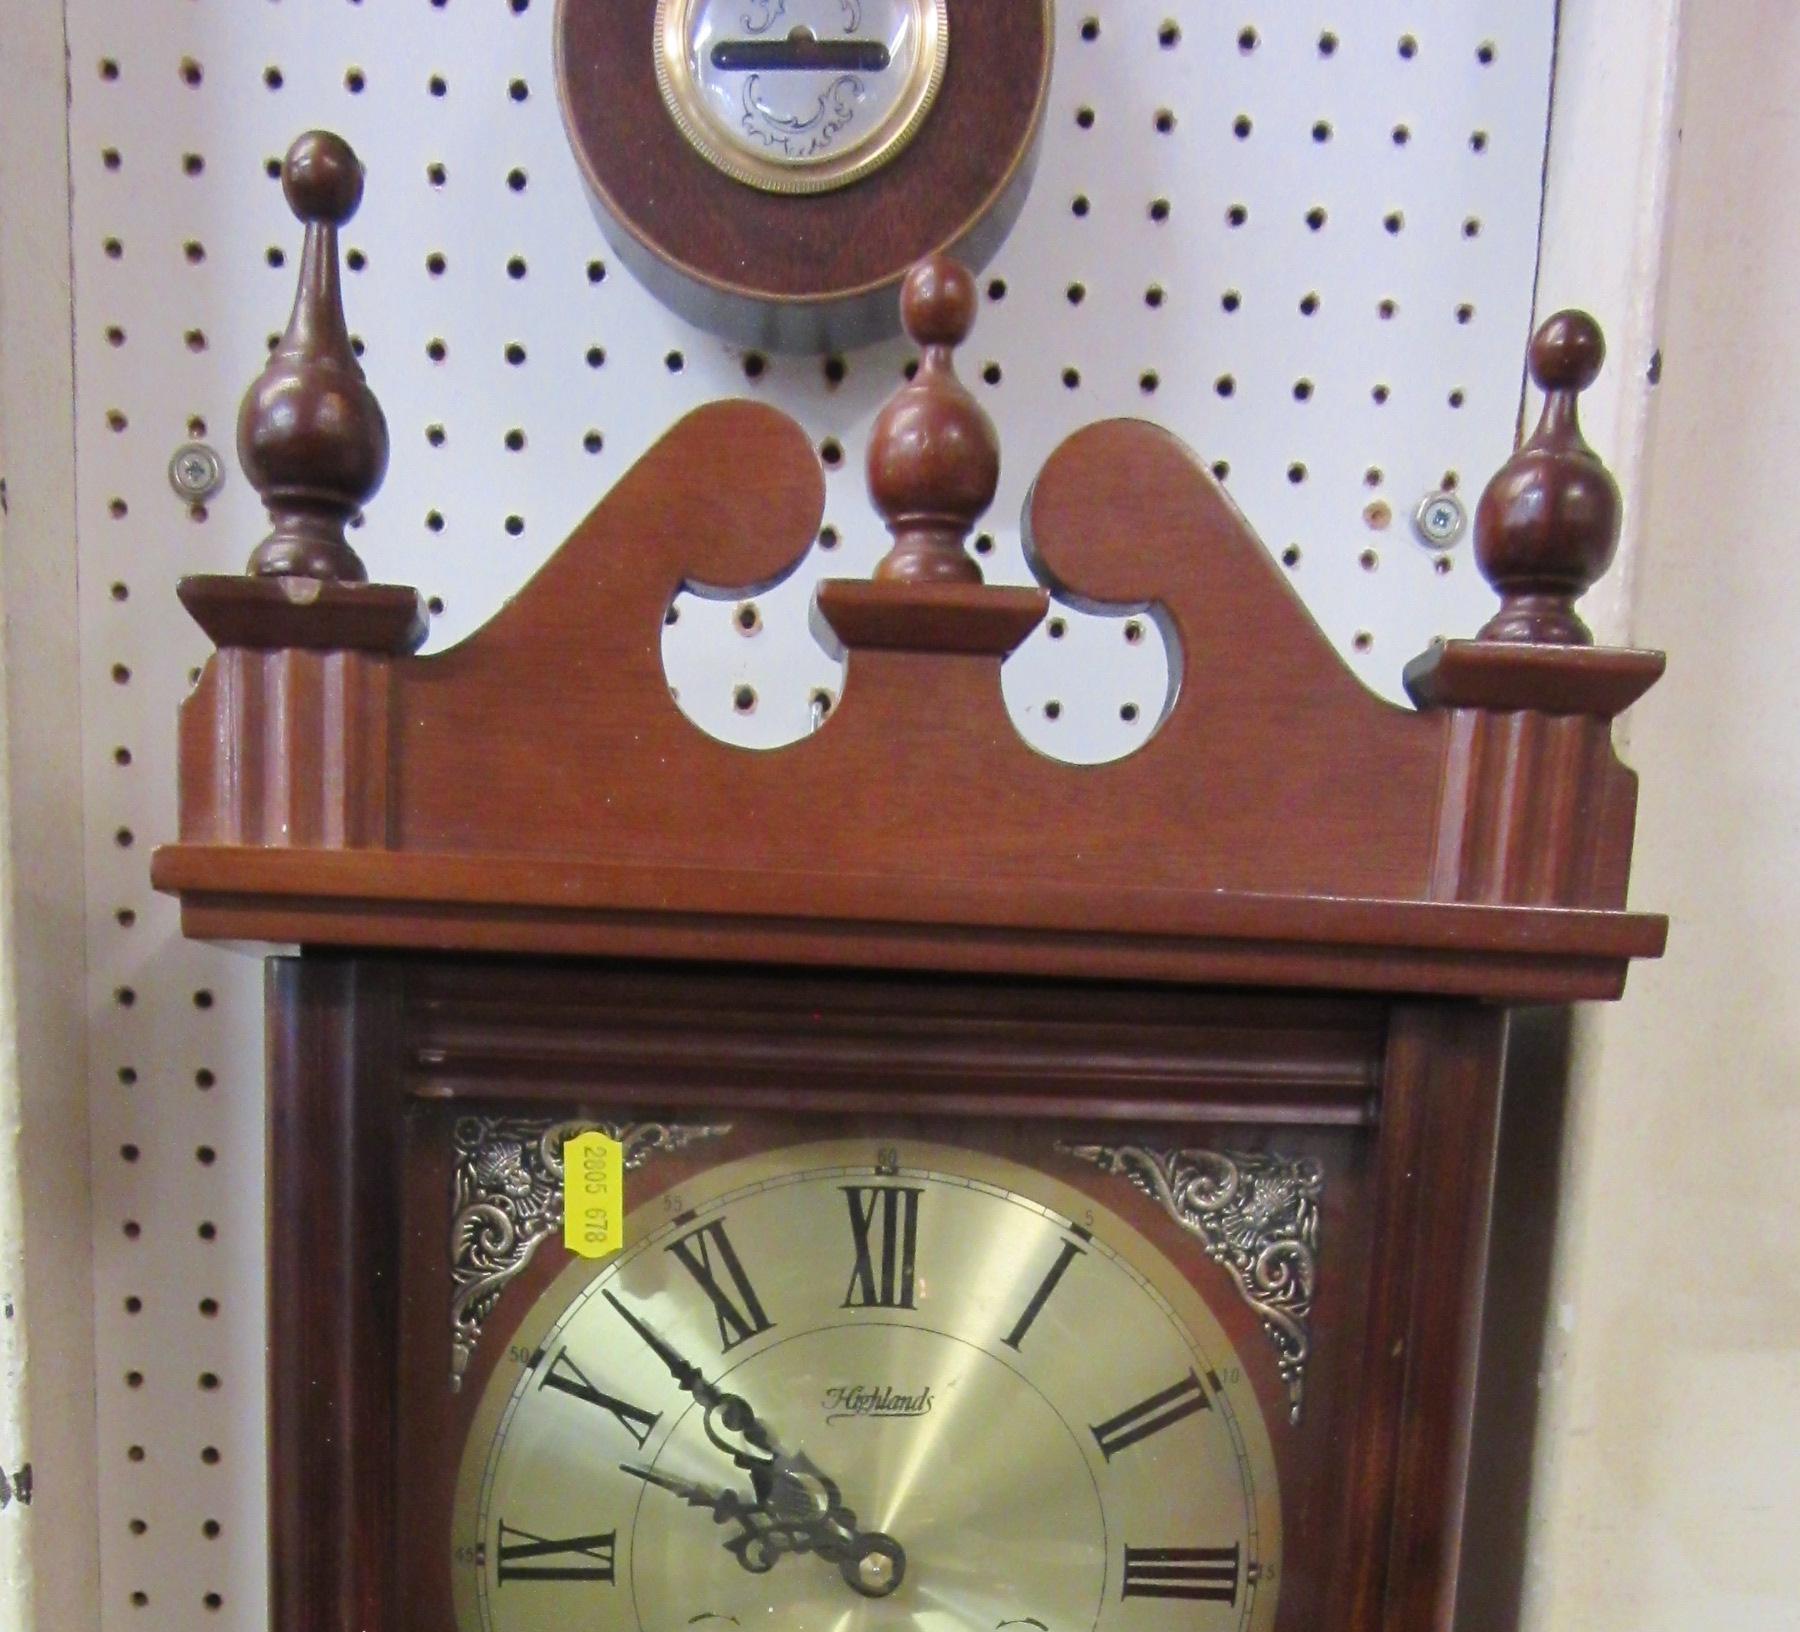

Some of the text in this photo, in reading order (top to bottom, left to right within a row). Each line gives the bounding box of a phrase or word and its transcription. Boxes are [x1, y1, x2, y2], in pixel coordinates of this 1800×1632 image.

[583, 1146, 608, 1243] 2805 678
[1084, 1210, 1094, 1226] 5
[664, 1215, 777, 1354] XI
[837, 1186, 925, 1310] XII
[1000, 1236, 1088, 1353] I
[509, 1347, 529, 1363] 50
[1222, 1368, 1240, 1384] 10
[538, 1345, 664, 1450] X
[822, 1385, 935, 1418] Highlands
[1088, 1366, 1213, 1463] II
[498, 1517, 616, 1588] IX
[1122, 1541, 1240, 1607] III
